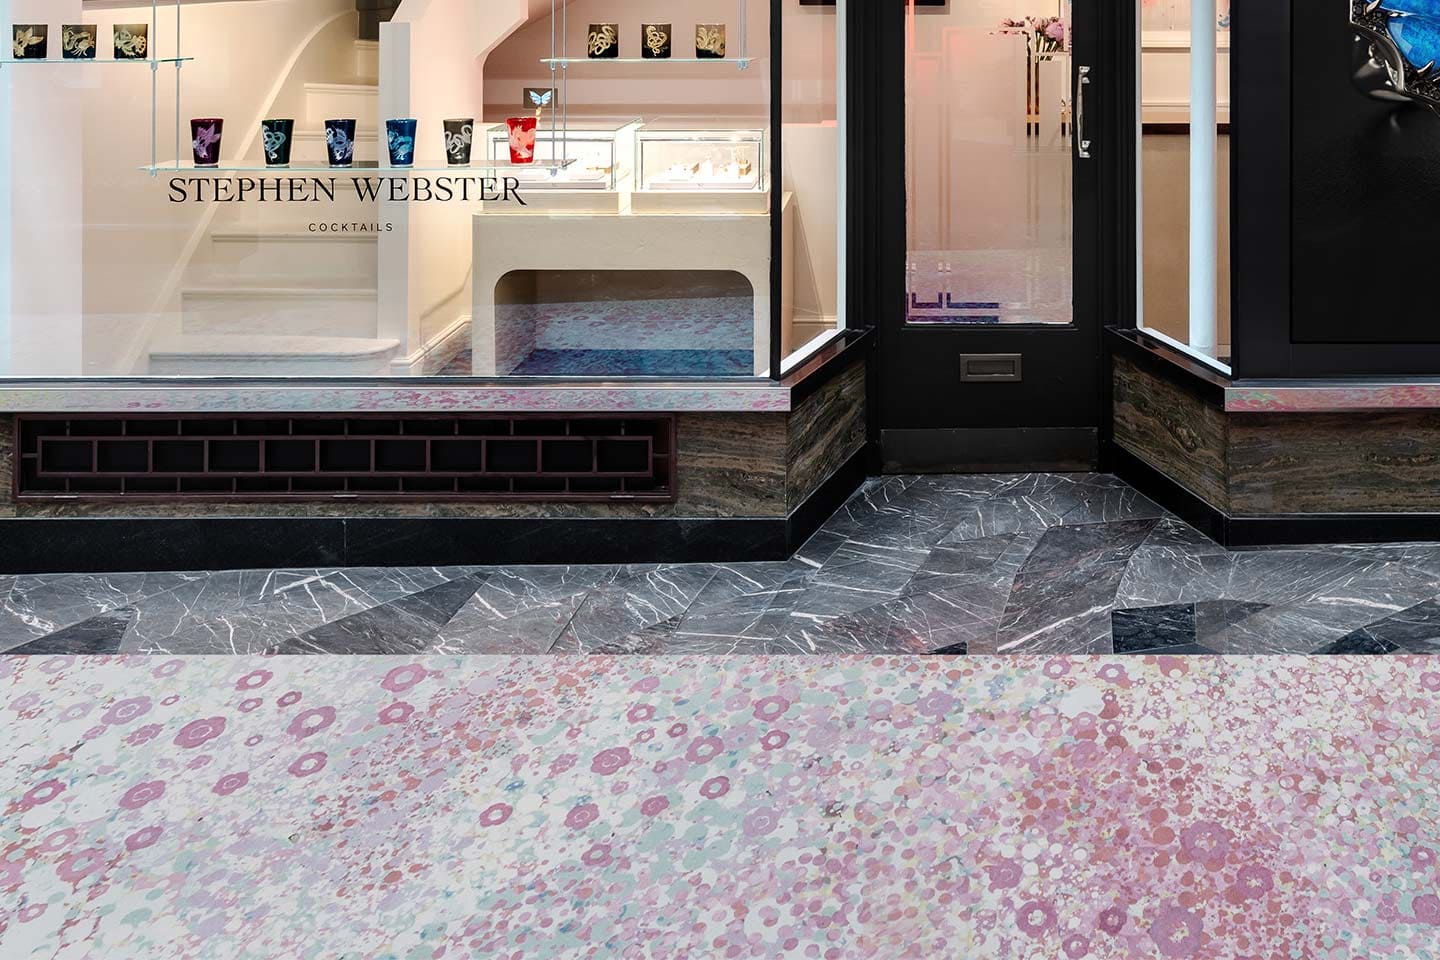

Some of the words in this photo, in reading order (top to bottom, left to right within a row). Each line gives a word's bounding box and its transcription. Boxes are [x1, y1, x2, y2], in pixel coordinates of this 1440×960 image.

[168, 178, 336, 203] STEPHEN
[350, 177, 527, 206] WEBSTER
[308, 222, 394, 233] COCKTAILS
